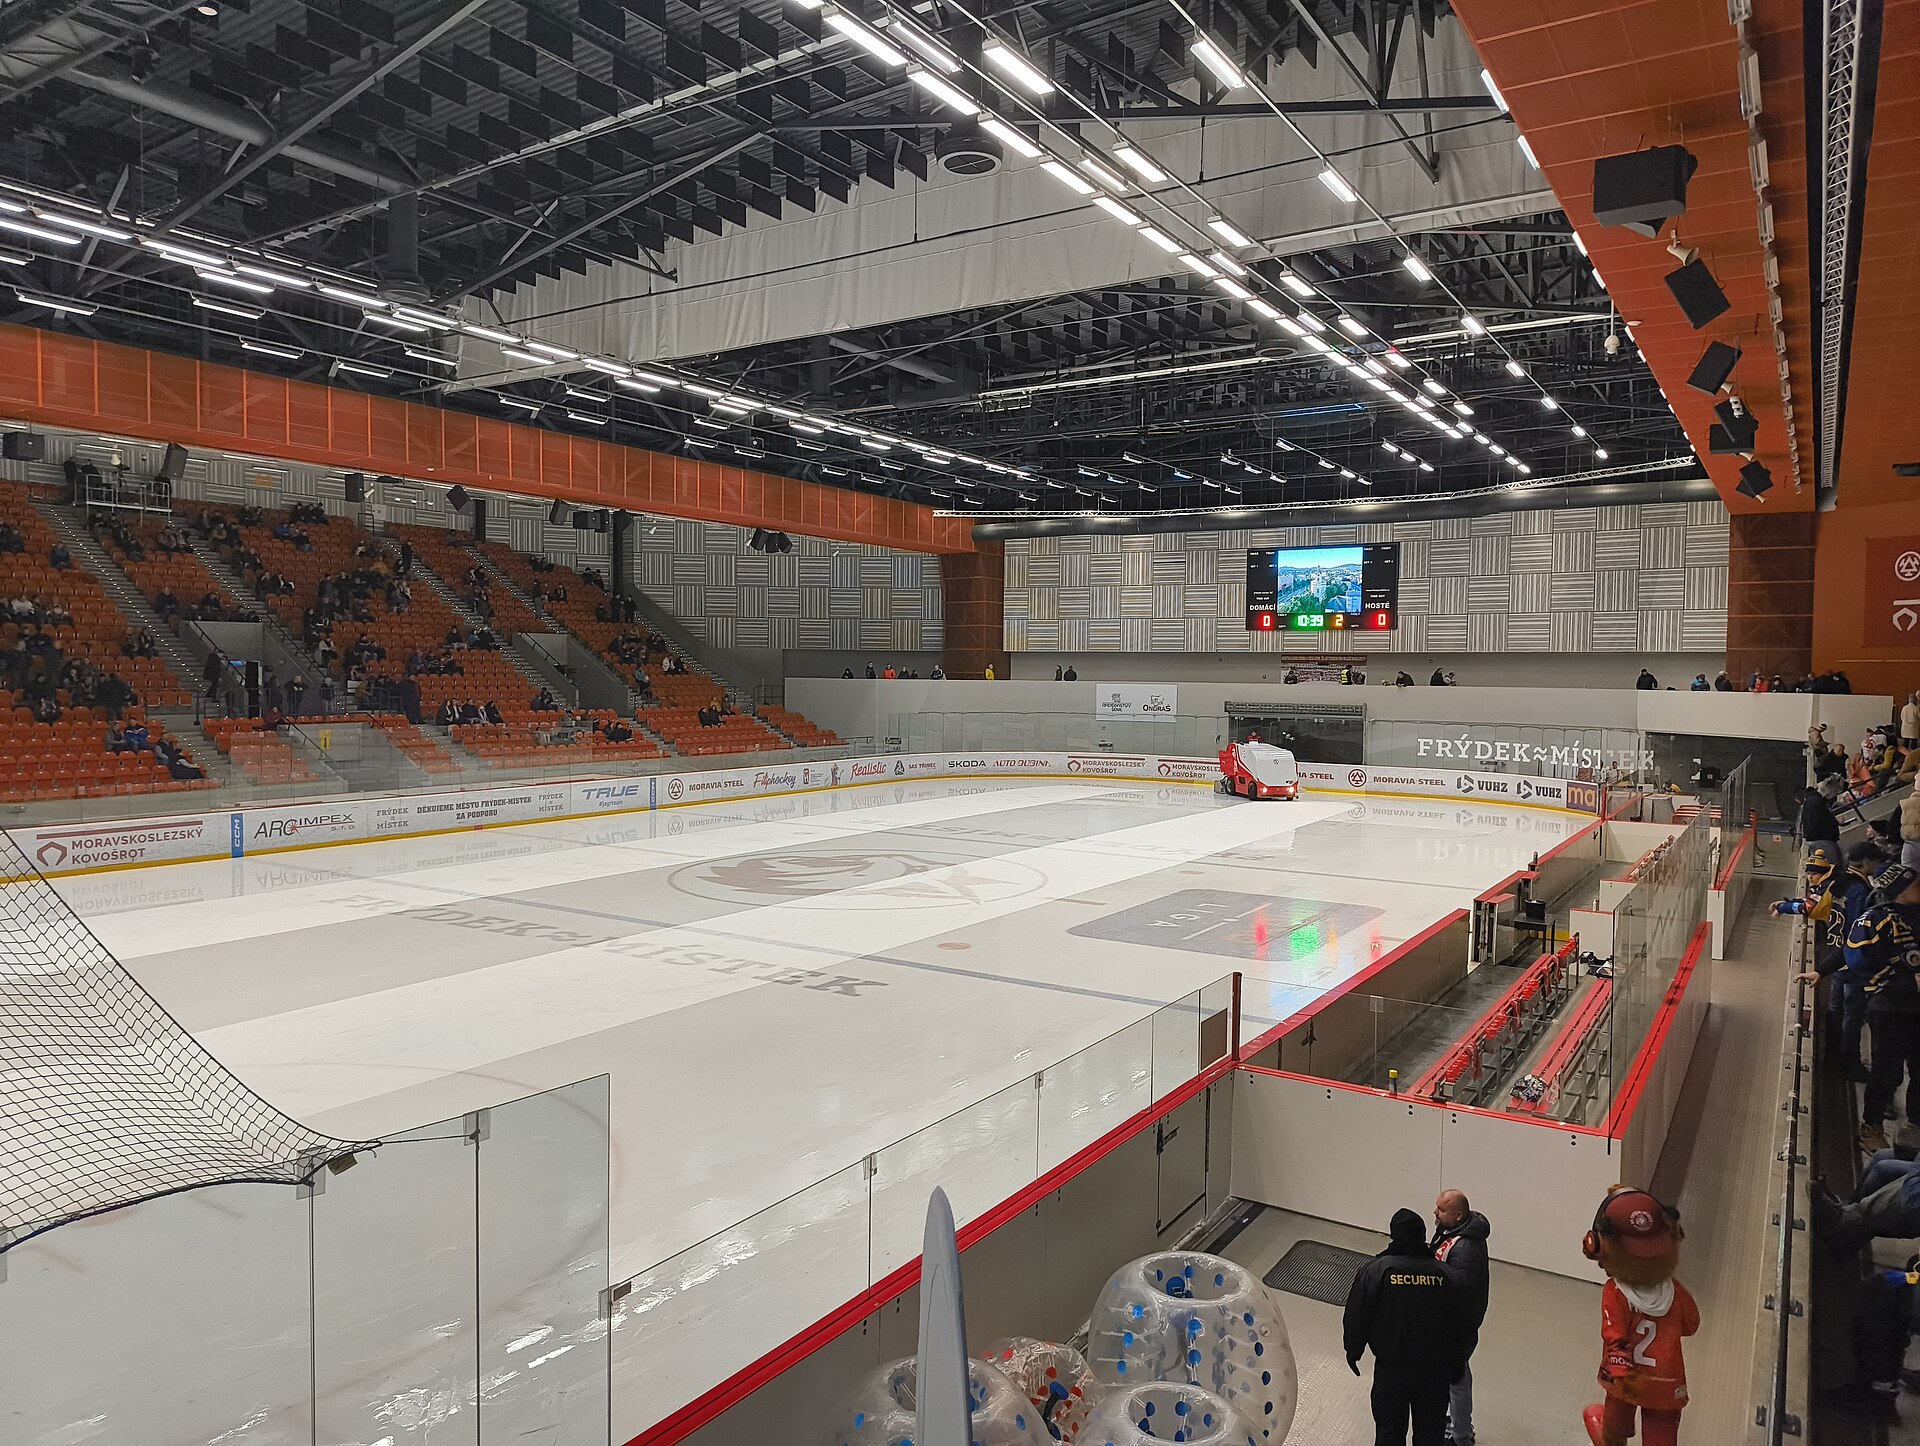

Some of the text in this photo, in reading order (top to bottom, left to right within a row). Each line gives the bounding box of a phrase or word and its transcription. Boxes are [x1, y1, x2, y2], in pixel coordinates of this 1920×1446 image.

[1250, 603, 1276, 611] DOMÁCÍ
[1263, 615, 1271, 627] 0
[1335, 614, 1344, 627] 2
[1377, 613, 1386, 626] 0
[1082, 760, 1145, 768] MORAVSKOSLEZSKÝ
[689, 779, 744, 792] MORAVIA STEEL
[1373, 776, 1446, 786] MORAVIA STEEL
[1477, 780, 1508, 793] VUHZ
[538, 792, 564, 801] FRÝDEK
[581, 785, 639, 800] TRUE
[1535, 785, 1562, 799] VUHZ
[417, 803, 455, 814] DĚKUJEME
[480, 796, 532, 808] FRÝDEK-MÍSTEK
[538, 803, 564, 813] MÍSTEK
[376, 807, 409, 817] FRÝDEK
[456, 809, 498, 820] ZA PODPORU
[376, 820, 409, 830] MÍSTEK
[72, 827, 204, 850] MORAVSKOSLEZSKÝ
[72, 848, 146, 865] KOVOŠROT
[1146, 903, 1230, 927] LIGA
[1390, 1274, 1444, 1286] SECURITY
[1633, 1319, 1657, 1368] 2
